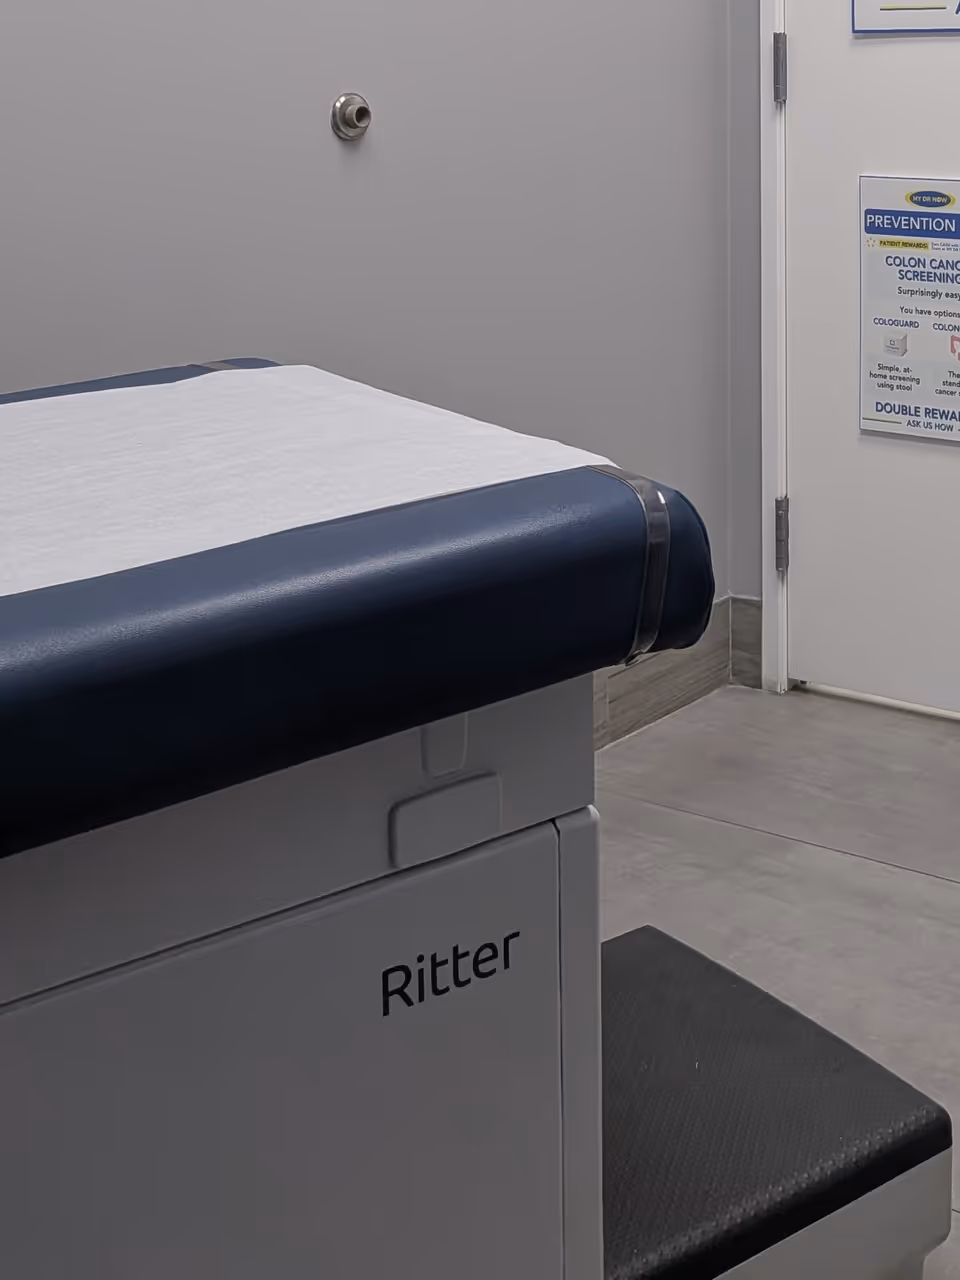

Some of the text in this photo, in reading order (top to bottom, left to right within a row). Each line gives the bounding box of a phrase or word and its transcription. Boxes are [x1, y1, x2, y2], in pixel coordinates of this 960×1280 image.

[867, 215, 955, 232] PREVENTION
[880, 240, 901, 248] PATIENT
[886, 256, 925, 268] COLON
[898, 287, 942, 299] Surprisingly
[900, 306, 913, 314] You
[873, 318, 919, 328] COLOGUARD
[878, 364, 912, 374] Simple, at-
[869, 371, 920, 385] home screening
[877, 381, 912, 391] using stool
[935, 389, 956, 397] cancer
[876, 402, 920, 417] DOUBLE
[907, 420, 921, 428] ASK
[935, 423, 953, 432] HOW
[382, 931, 520, 1017] Ritter
